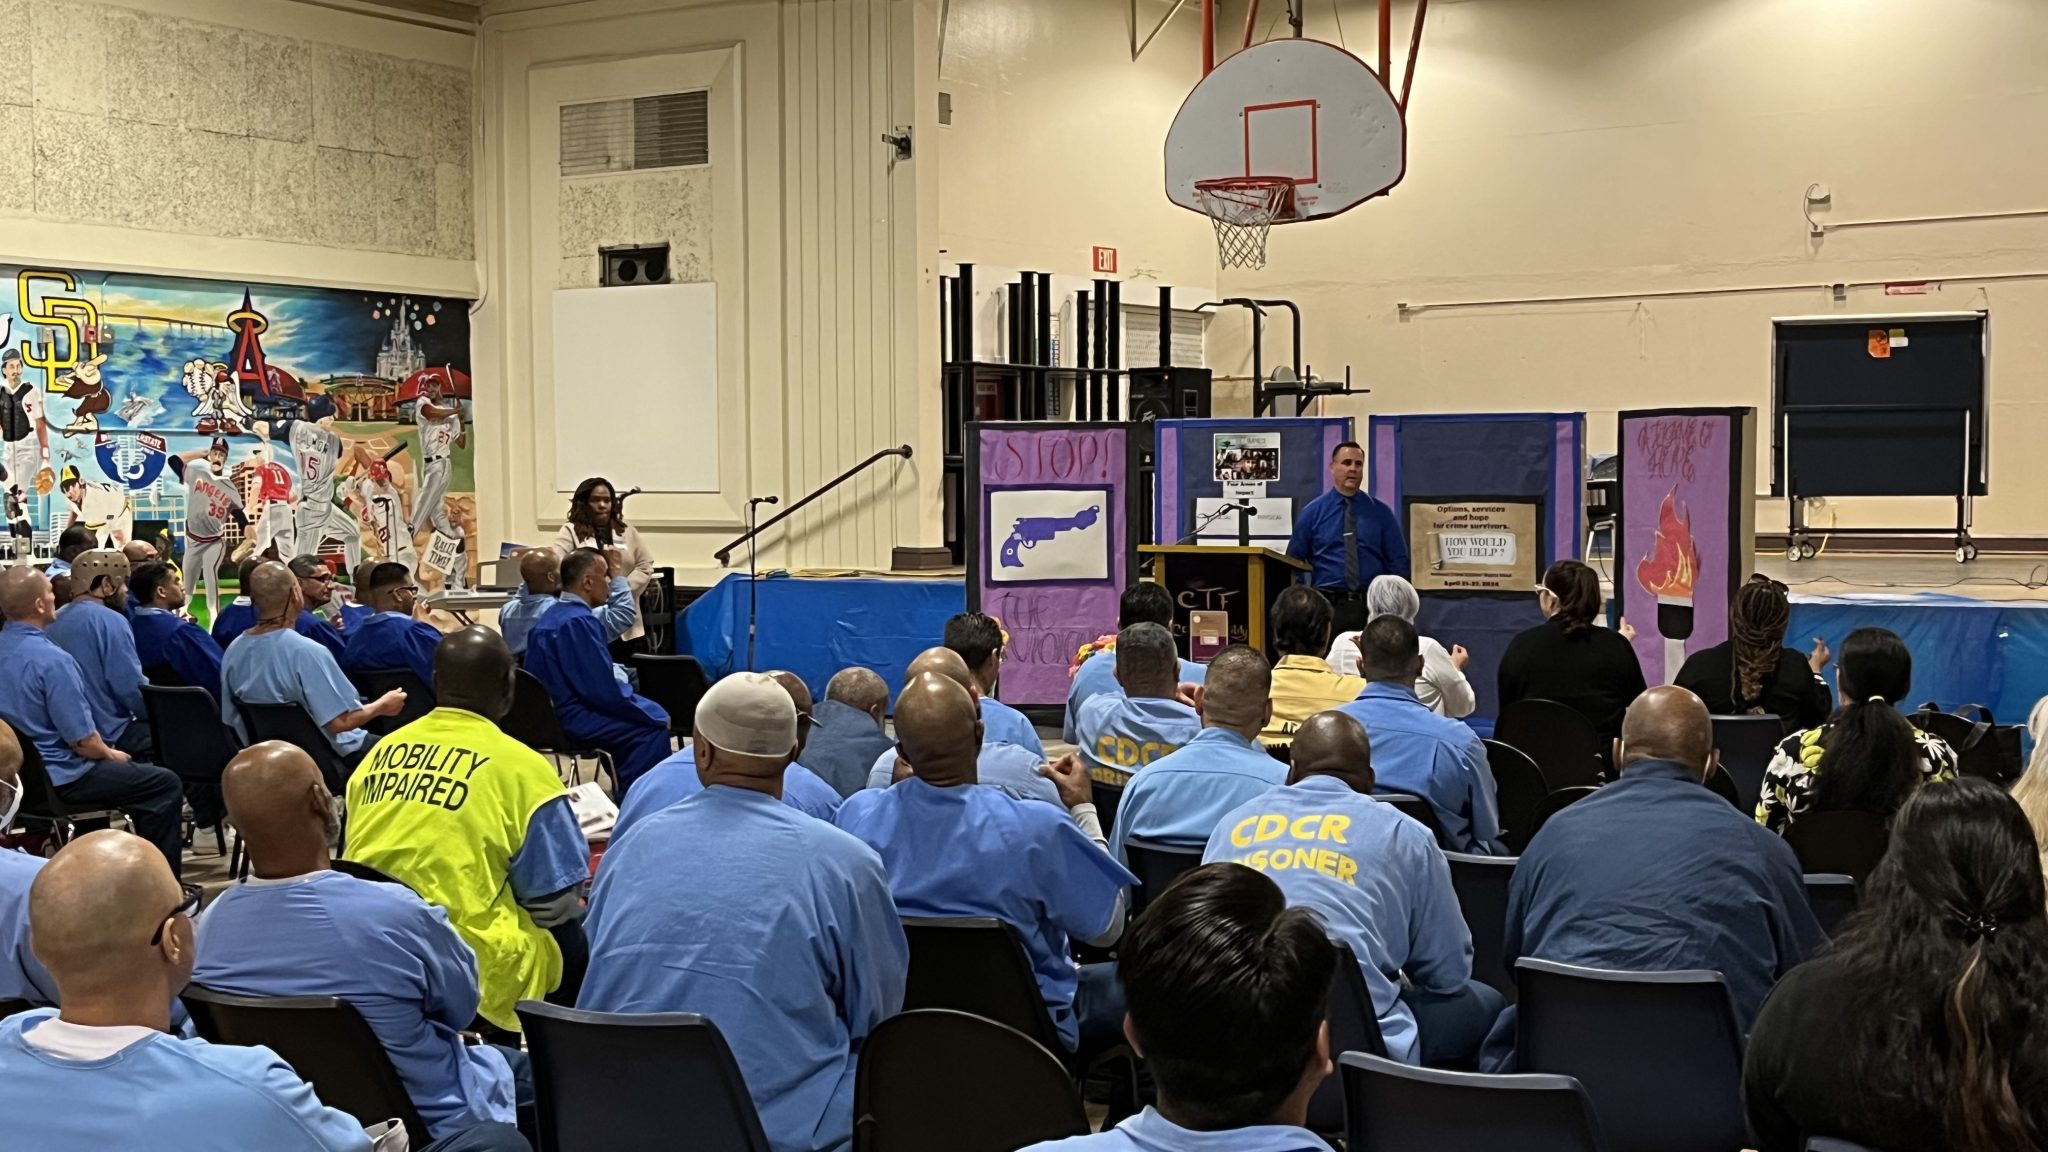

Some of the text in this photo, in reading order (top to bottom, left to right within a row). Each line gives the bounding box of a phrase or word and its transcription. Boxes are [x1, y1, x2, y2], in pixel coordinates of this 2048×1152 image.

[208, 501, 226, 519] 39
[1437, 505, 1470, 514] Options,
[1453, 513, 1490, 522] and hope
[1445, 537, 1507, 547] HOW WOULD
[1447, 547, 1466, 556] YOU
[1469, 547, 1498, 557] HELP
[1177, 586, 1241, 611] CTF
[368, 742, 491, 780] MOBILITY
[361, 772, 470, 812] IMPAIRED
[1230, 813, 1353, 849] CDCR
[1232, 848, 1359, 887] ISONER
